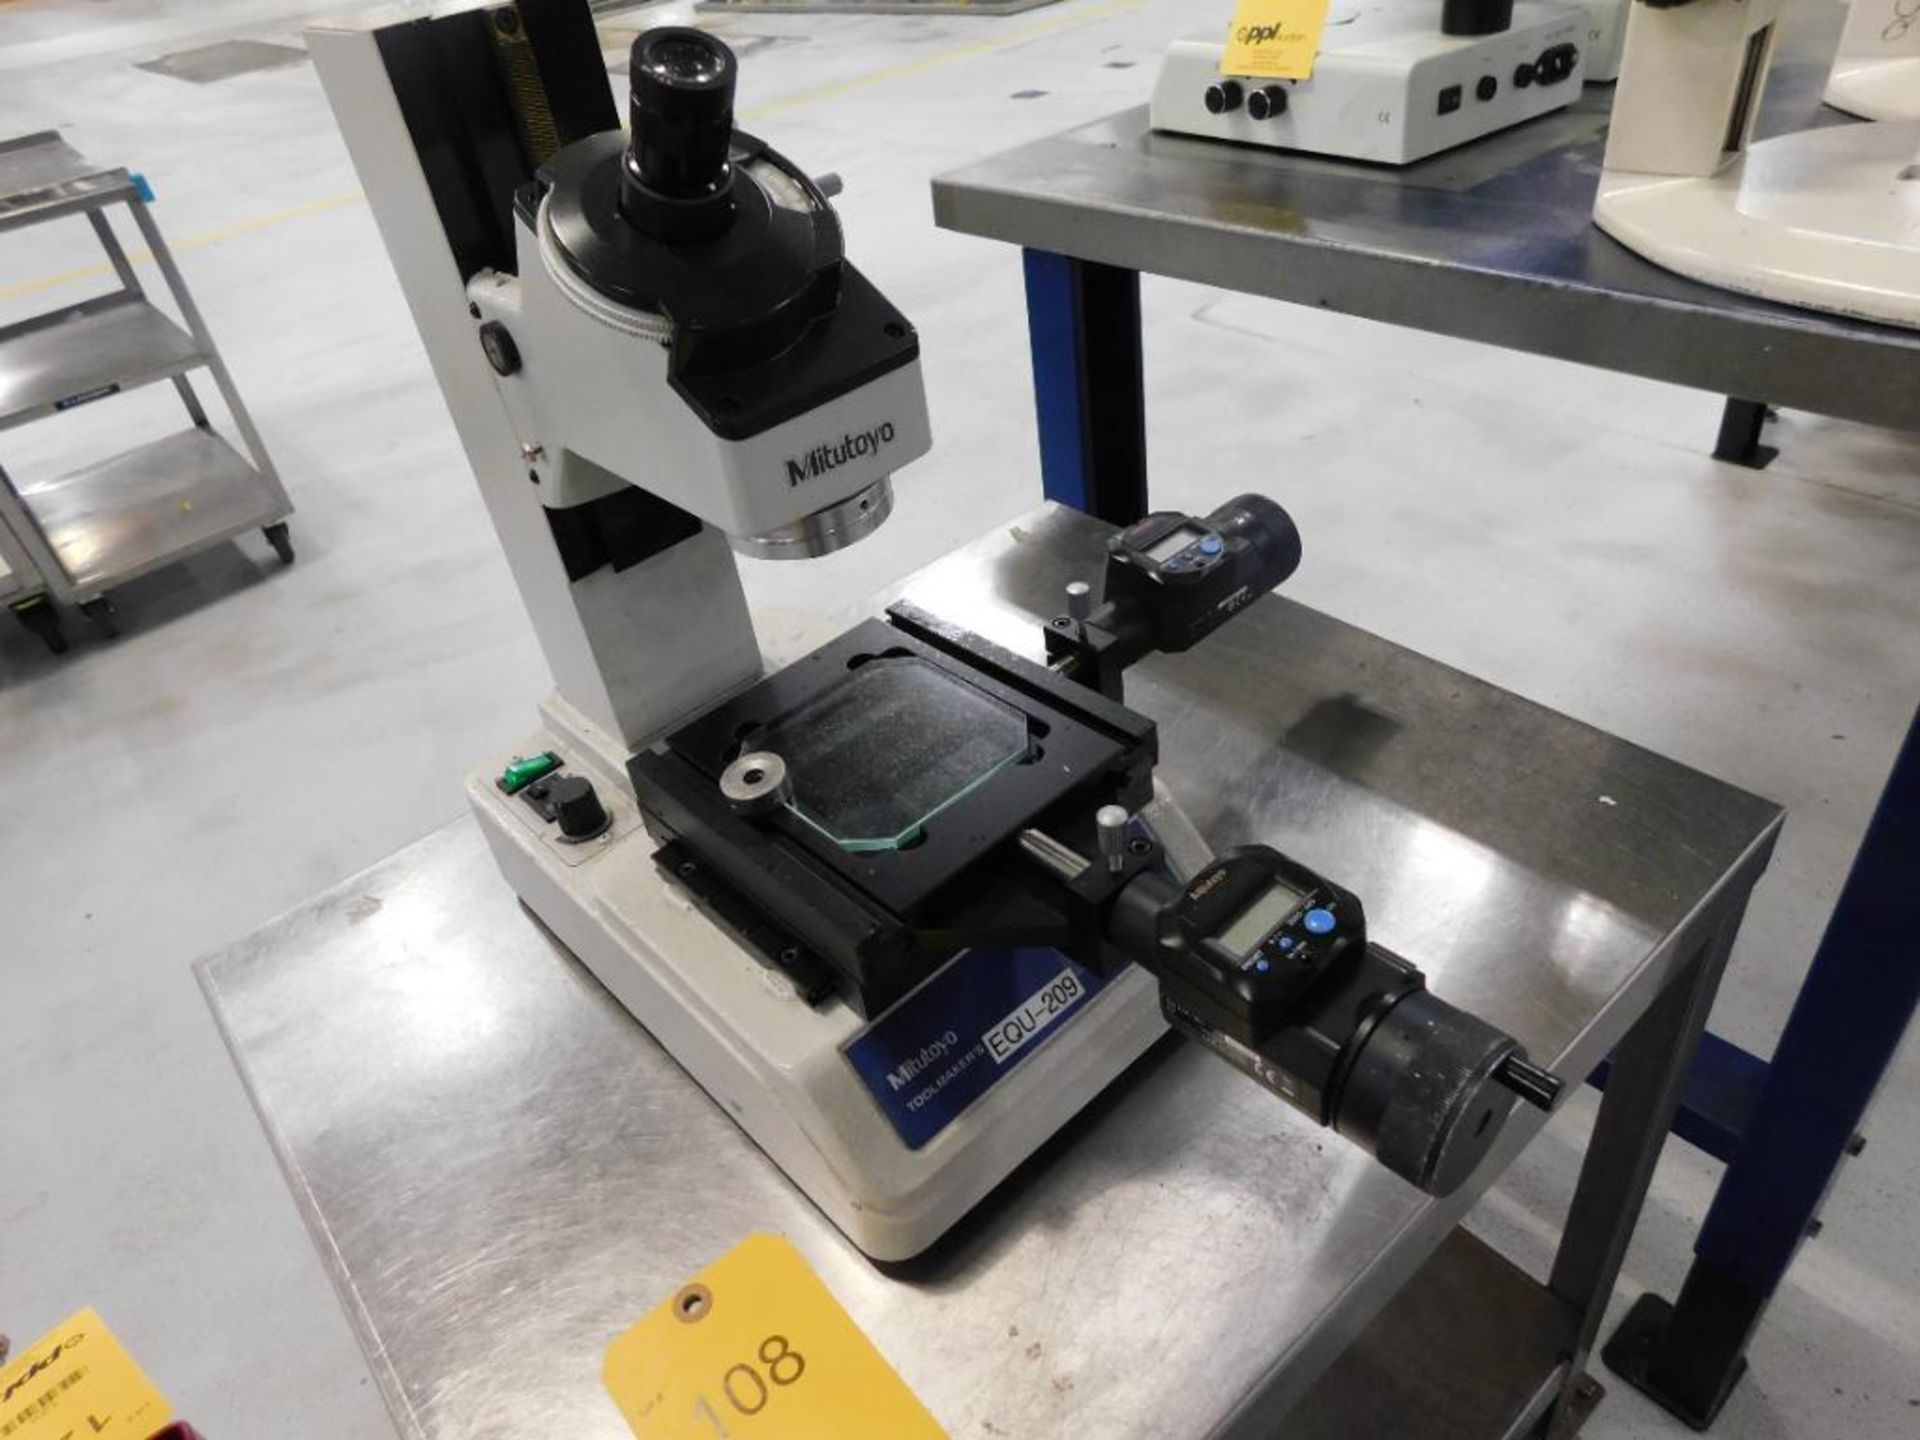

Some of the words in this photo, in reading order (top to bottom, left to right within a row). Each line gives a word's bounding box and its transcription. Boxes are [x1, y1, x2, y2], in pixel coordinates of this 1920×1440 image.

[786, 422, 895, 487] Mitutoyo
[988, 975, 1079, 1057] EQU-209
[886, 1030, 959, 1092] Mitutoyo
[691, 1334, 806, 1439] 108
